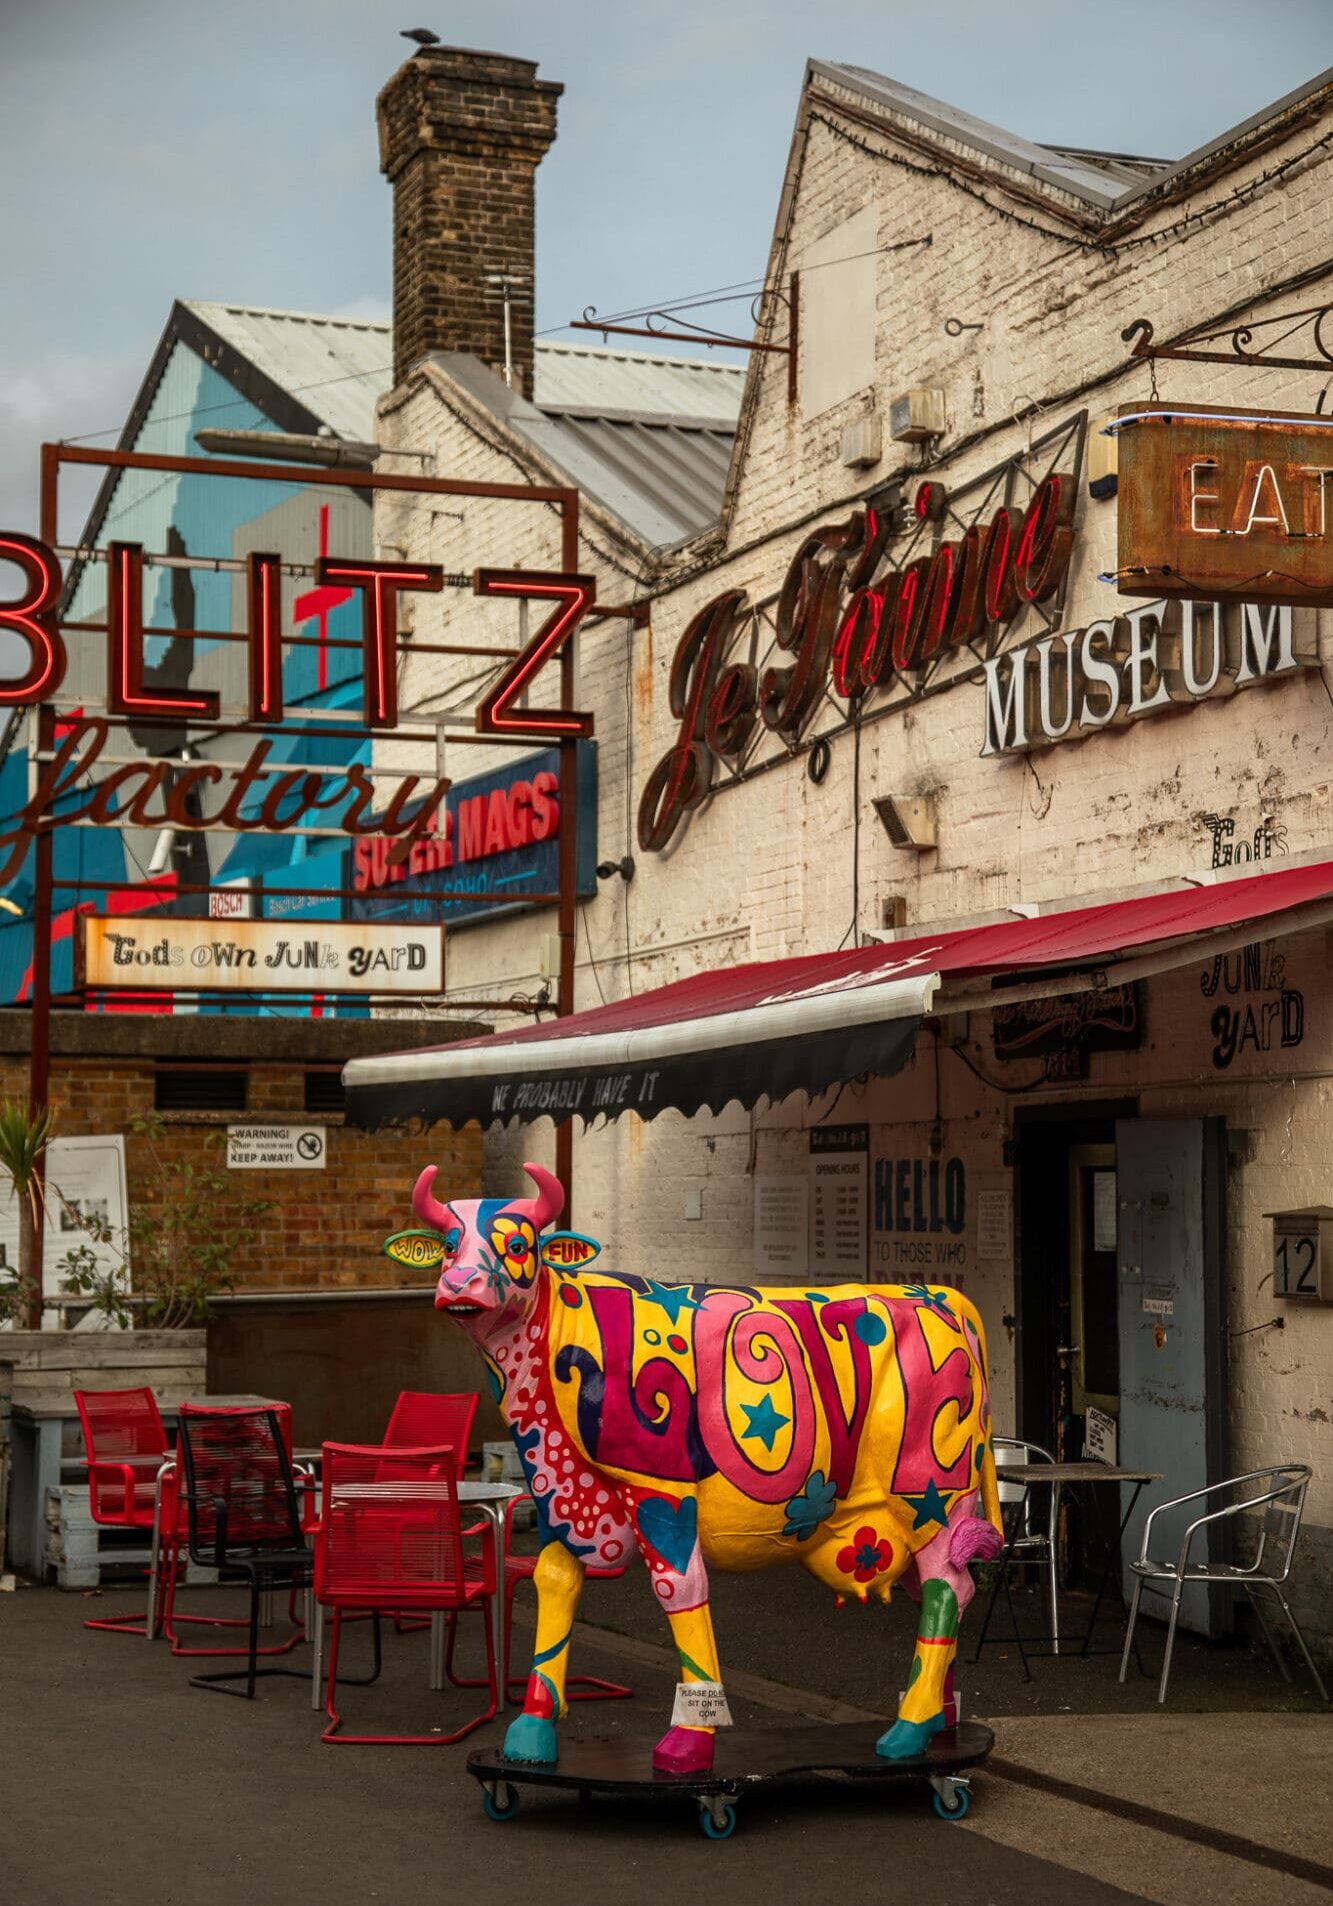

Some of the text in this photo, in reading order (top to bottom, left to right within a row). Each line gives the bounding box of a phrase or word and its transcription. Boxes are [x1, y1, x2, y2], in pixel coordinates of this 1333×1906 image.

[1176, 456, 1333, 538] EAT
[980, 598, 1297, 758] MUSEUM
[0, 722, 452, 885] factory
[458, 771, 559, 862] MAGS
[211, 892, 243, 918] BOSCH
[492, 1072, 660, 1112] WE PROBABLY HAVE IT
[235, 1129, 289, 1139] WARNING!
[231, 1153, 294, 1163] KEEP AWAY!
[874, 1157, 966, 1234] HELLO
[548, 1243, 589, 1264] FUN
[875, 1241, 966, 1264] TO THOSE WHO
[1276, 1238, 1317, 1292] 12
[584, 1285, 973, 1504] LOVE
[681, 1689, 707, 1697] PLEASE
[687, 1699, 699, 1707] SIT
[701, 1699, 713, 1707] ON
[698, 1710, 717, 1718] COW
